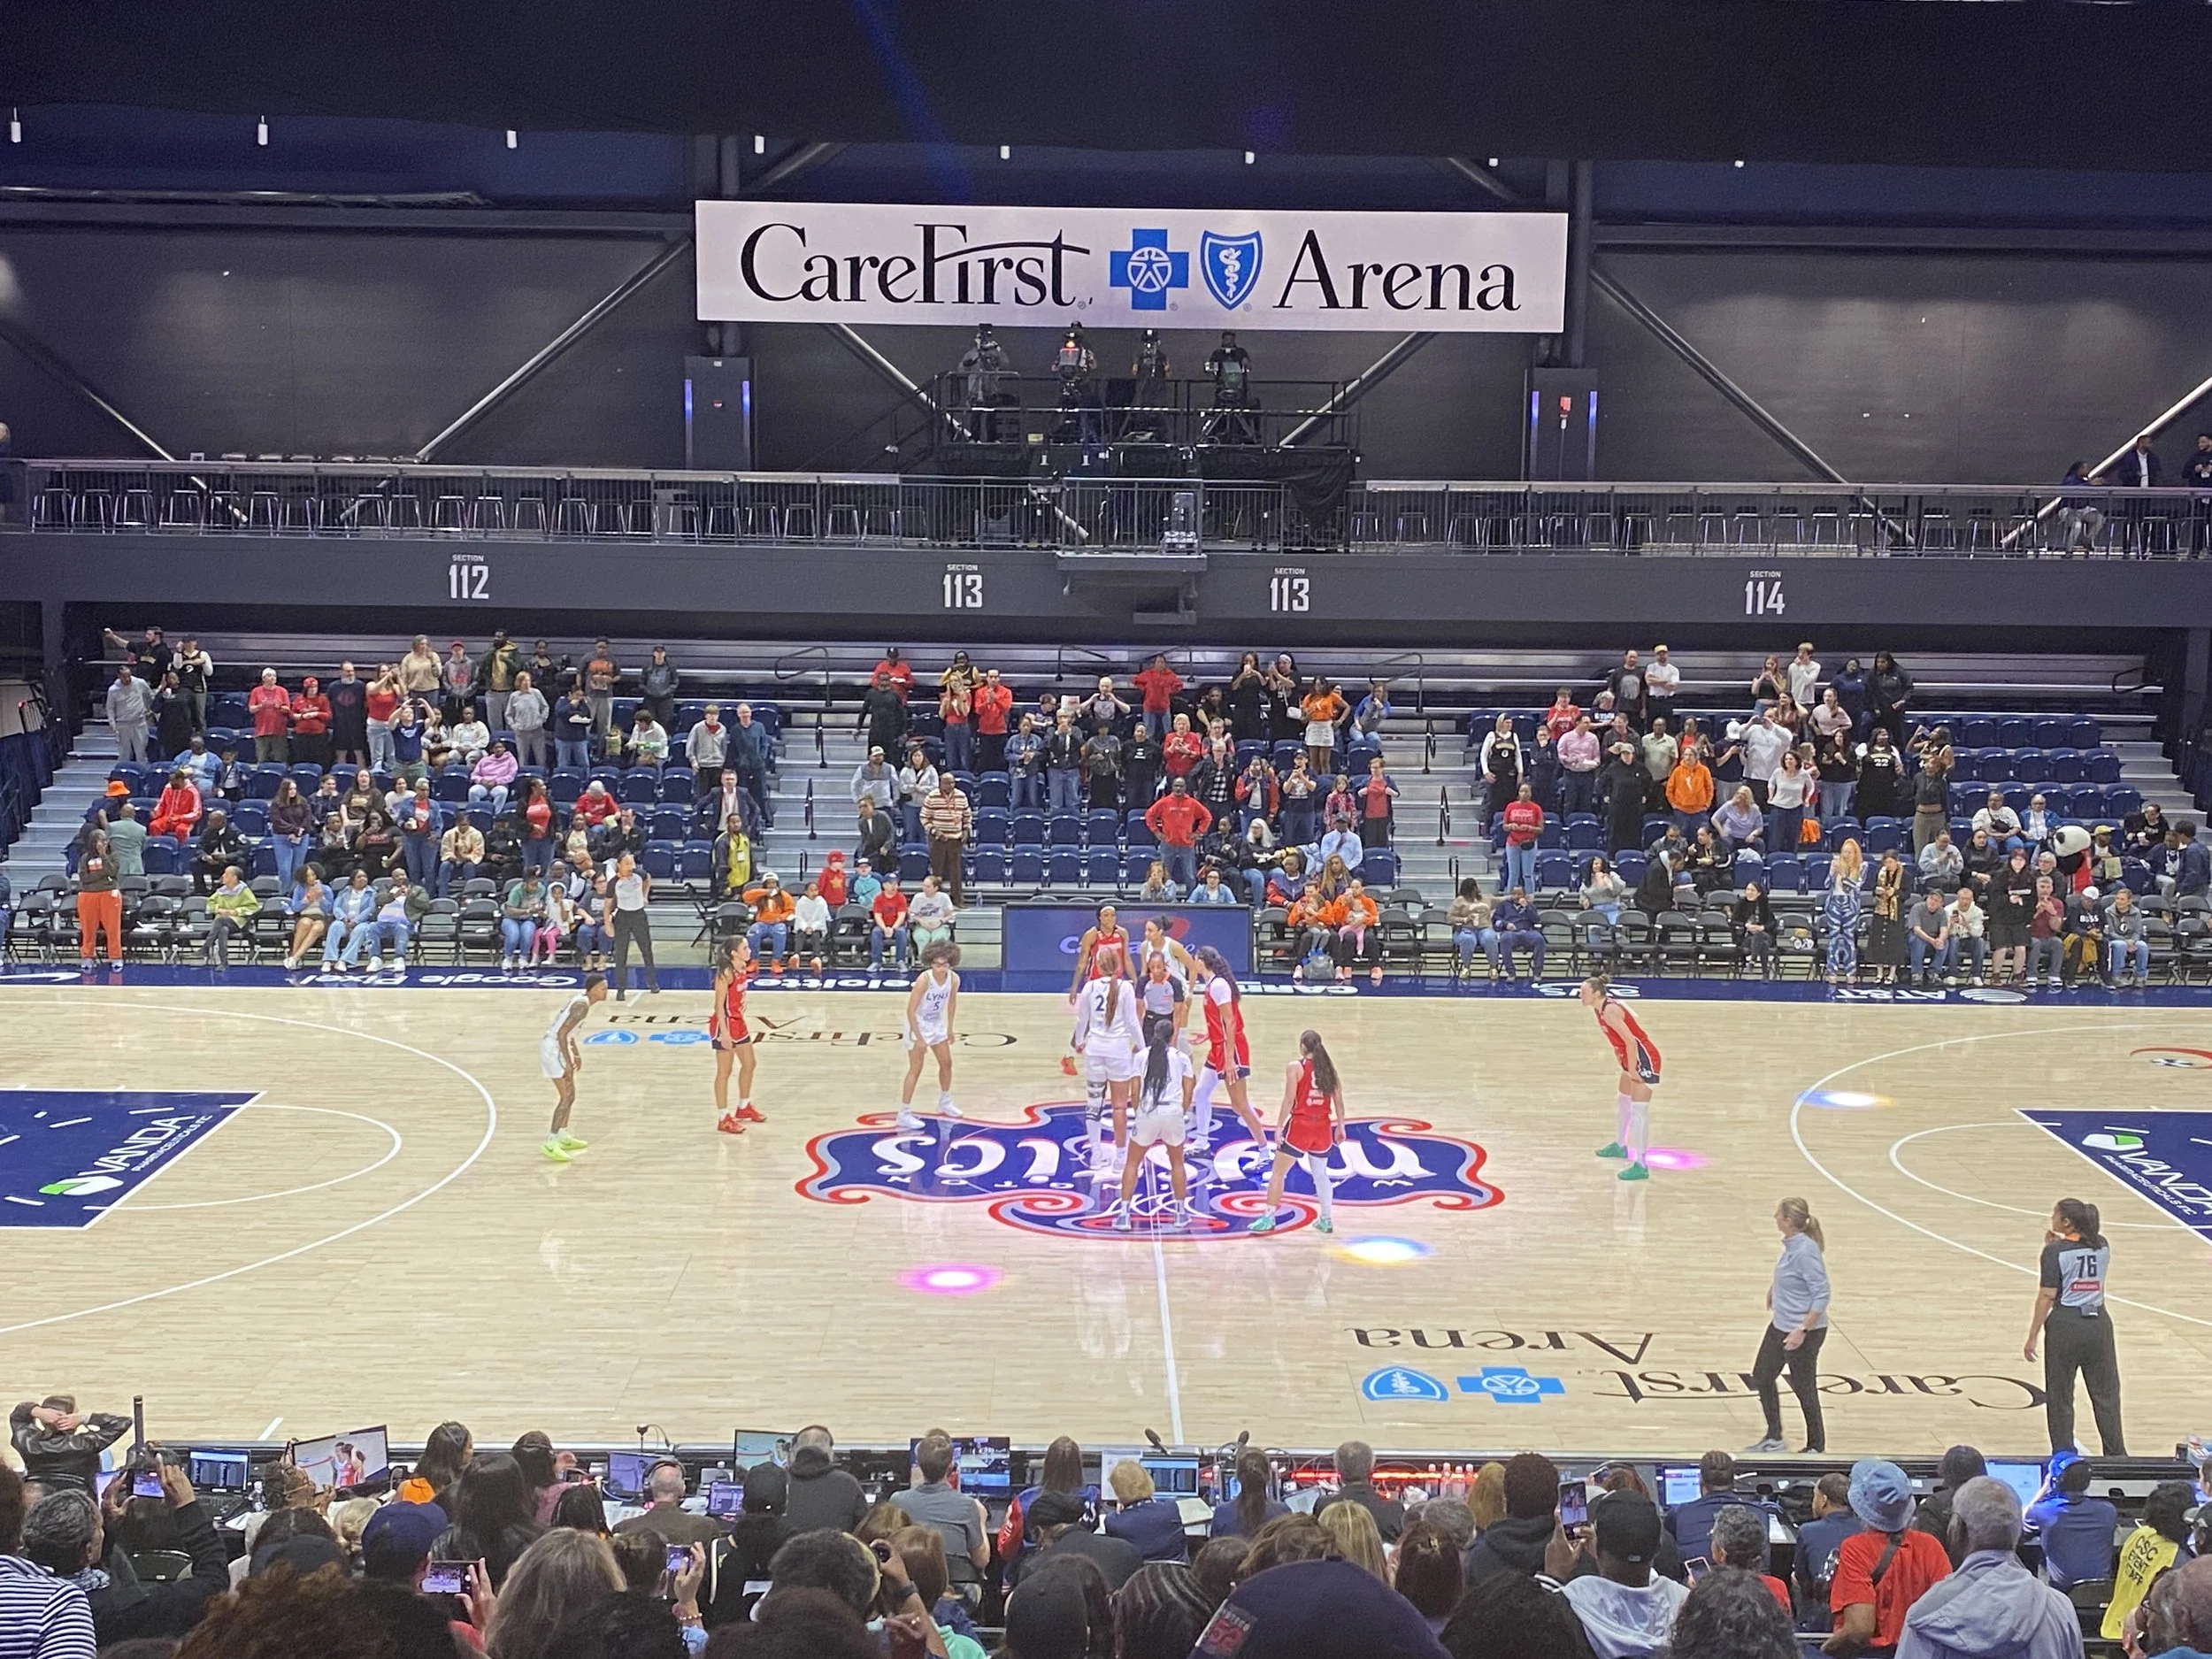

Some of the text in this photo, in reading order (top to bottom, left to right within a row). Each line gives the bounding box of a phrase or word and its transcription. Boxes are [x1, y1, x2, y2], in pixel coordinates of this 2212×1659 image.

[741, 223, 1522, 311] CareFirst Arena
[449, 564, 489, 599] 112
[942, 573, 983, 608] 113
[1270, 578, 1310, 611] 113
[1745, 580, 1786, 615] 114
[300, 973, 578, 987] Google Pixel
[747, 978, 917, 989] eloitte.
[1836, 988, 1946, 1000] AT&T
[608, 1015, 805, 1029] Aena
[78, 1115, 196, 1176] VANDA
[2077, 1255, 2097, 1279] 76
[1343, 1327, 1661, 1365] Arena
[2128, 1549, 2149, 1574] EVENT
[2135, 1535, 2158, 1562] CSC
